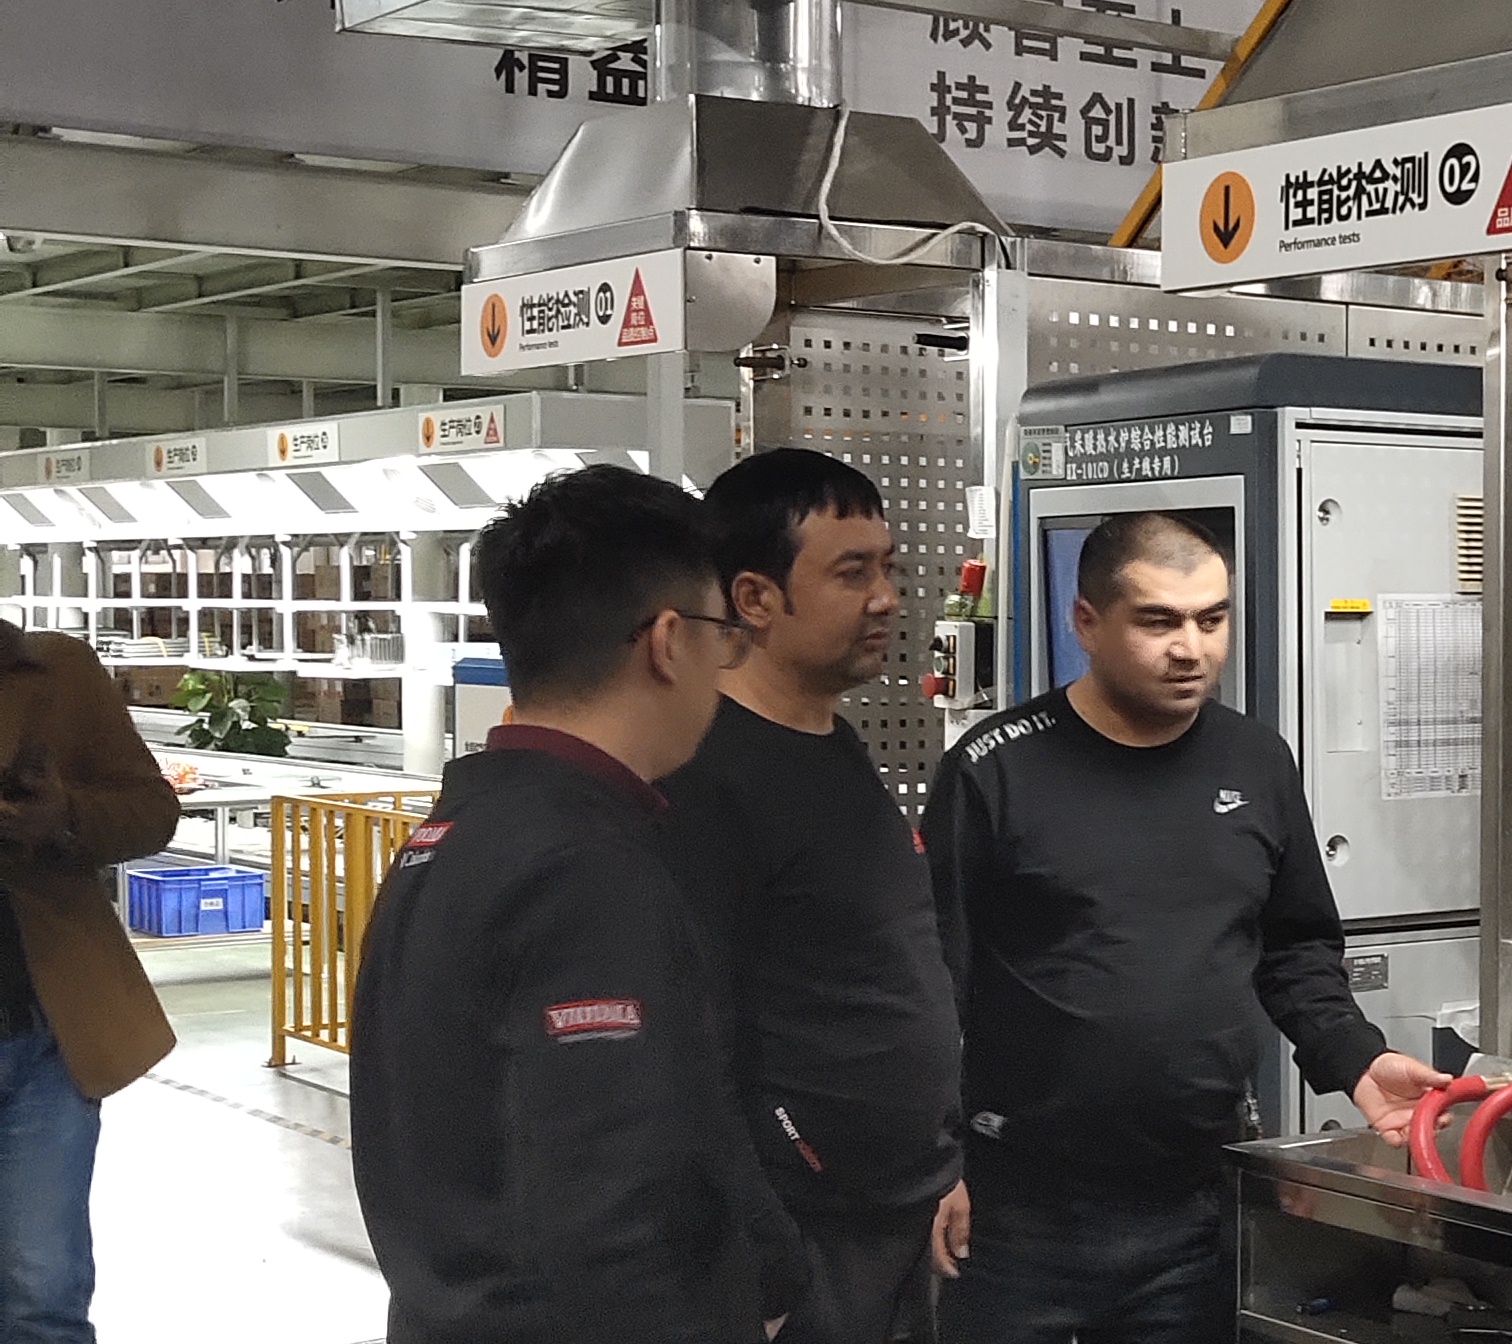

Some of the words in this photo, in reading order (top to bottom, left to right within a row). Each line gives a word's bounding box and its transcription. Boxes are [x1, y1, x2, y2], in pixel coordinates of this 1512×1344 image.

[929, 70, 1165, 166] 持续创
[1280, 151, 1429, 231] 性能检测
[1442, 155, 1477, 194] 02
[1278, 235, 1337, 253] Performance
[1338, 232, 1361, 246] tests
[519, 286, 591, 337] 性能检测
[596, 291, 614, 318] 01
[965, 726, 1006, 764] JUST
[1004, 719, 1033, 740] DO
[774, 1107, 801, 1141] SPORT
